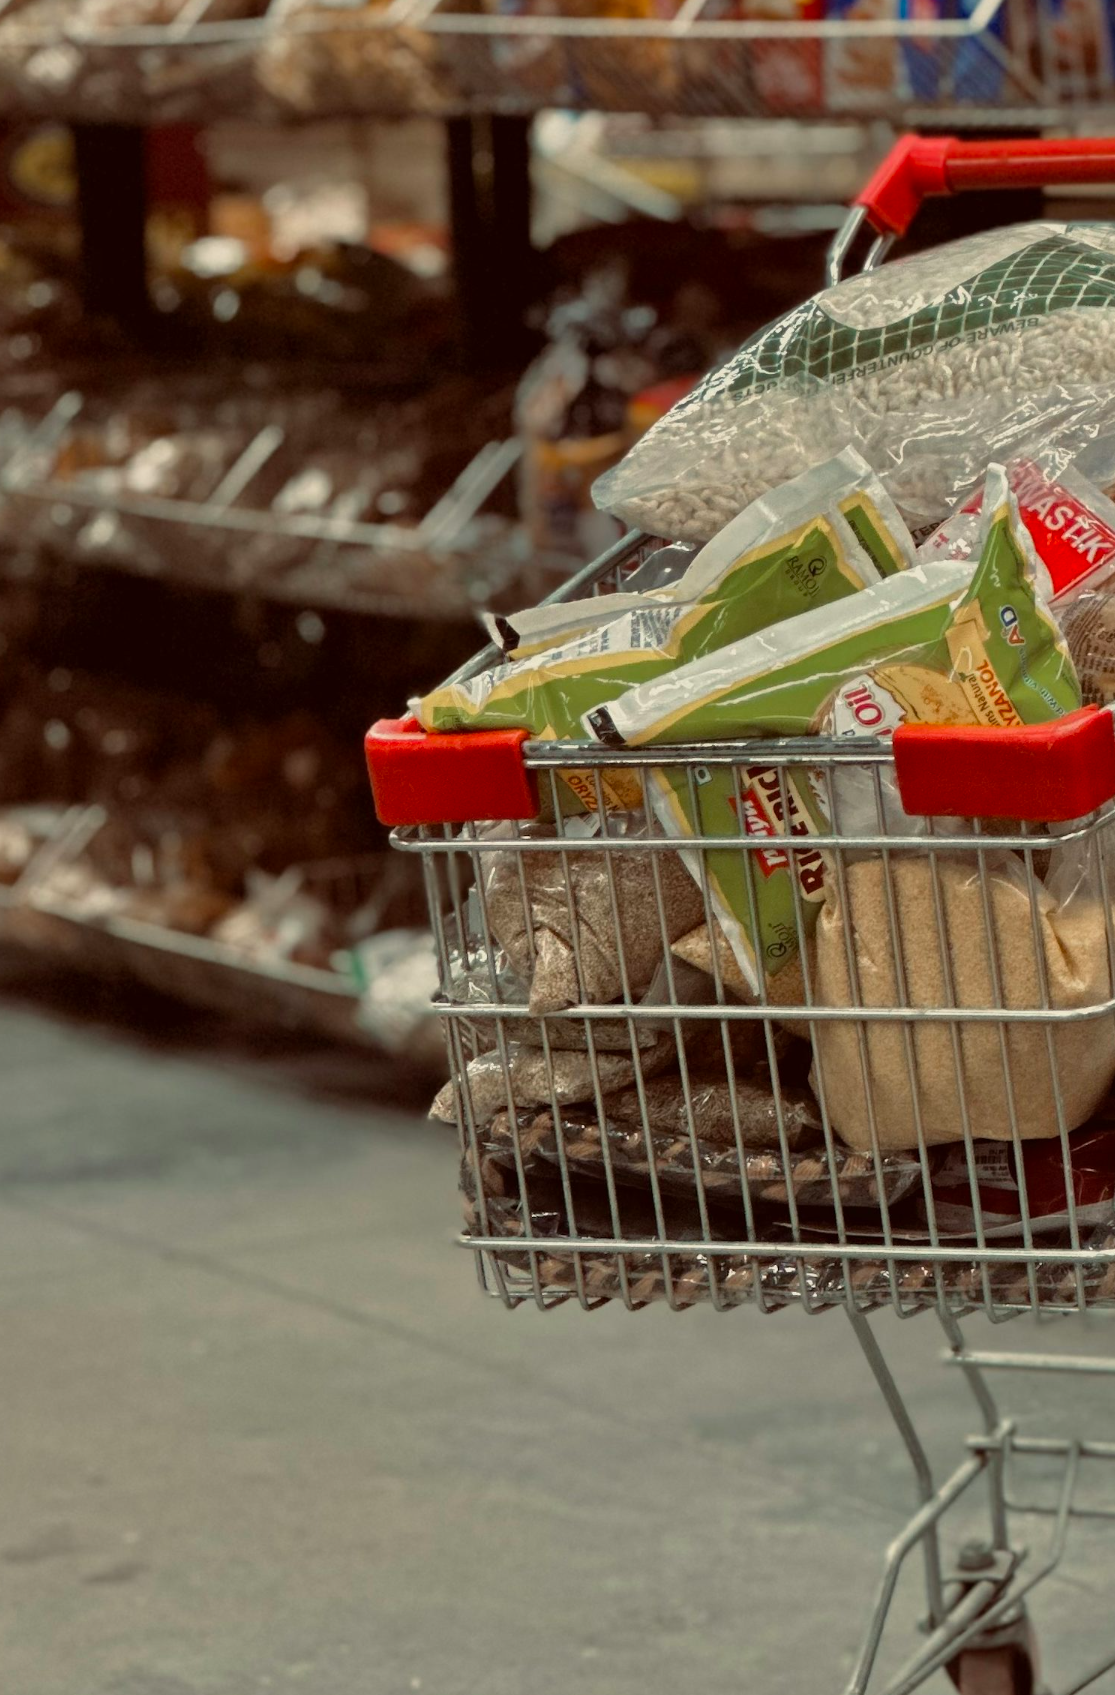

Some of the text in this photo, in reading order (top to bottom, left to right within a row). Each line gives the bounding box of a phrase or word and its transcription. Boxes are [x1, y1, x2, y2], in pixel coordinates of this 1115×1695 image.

[932, 335, 963, 351] OF
[966, 317, 1039, 343] BEWARE
[831, 345, 934, 386] COUNTERFEI
[1014, 468, 1114, 564] WASTIK
[1000, 605, 1018, 627] D
[1008, 625, 1025, 644] A
[843, 682, 883, 726] Oil
[967, 672, 990, 712] Natural
